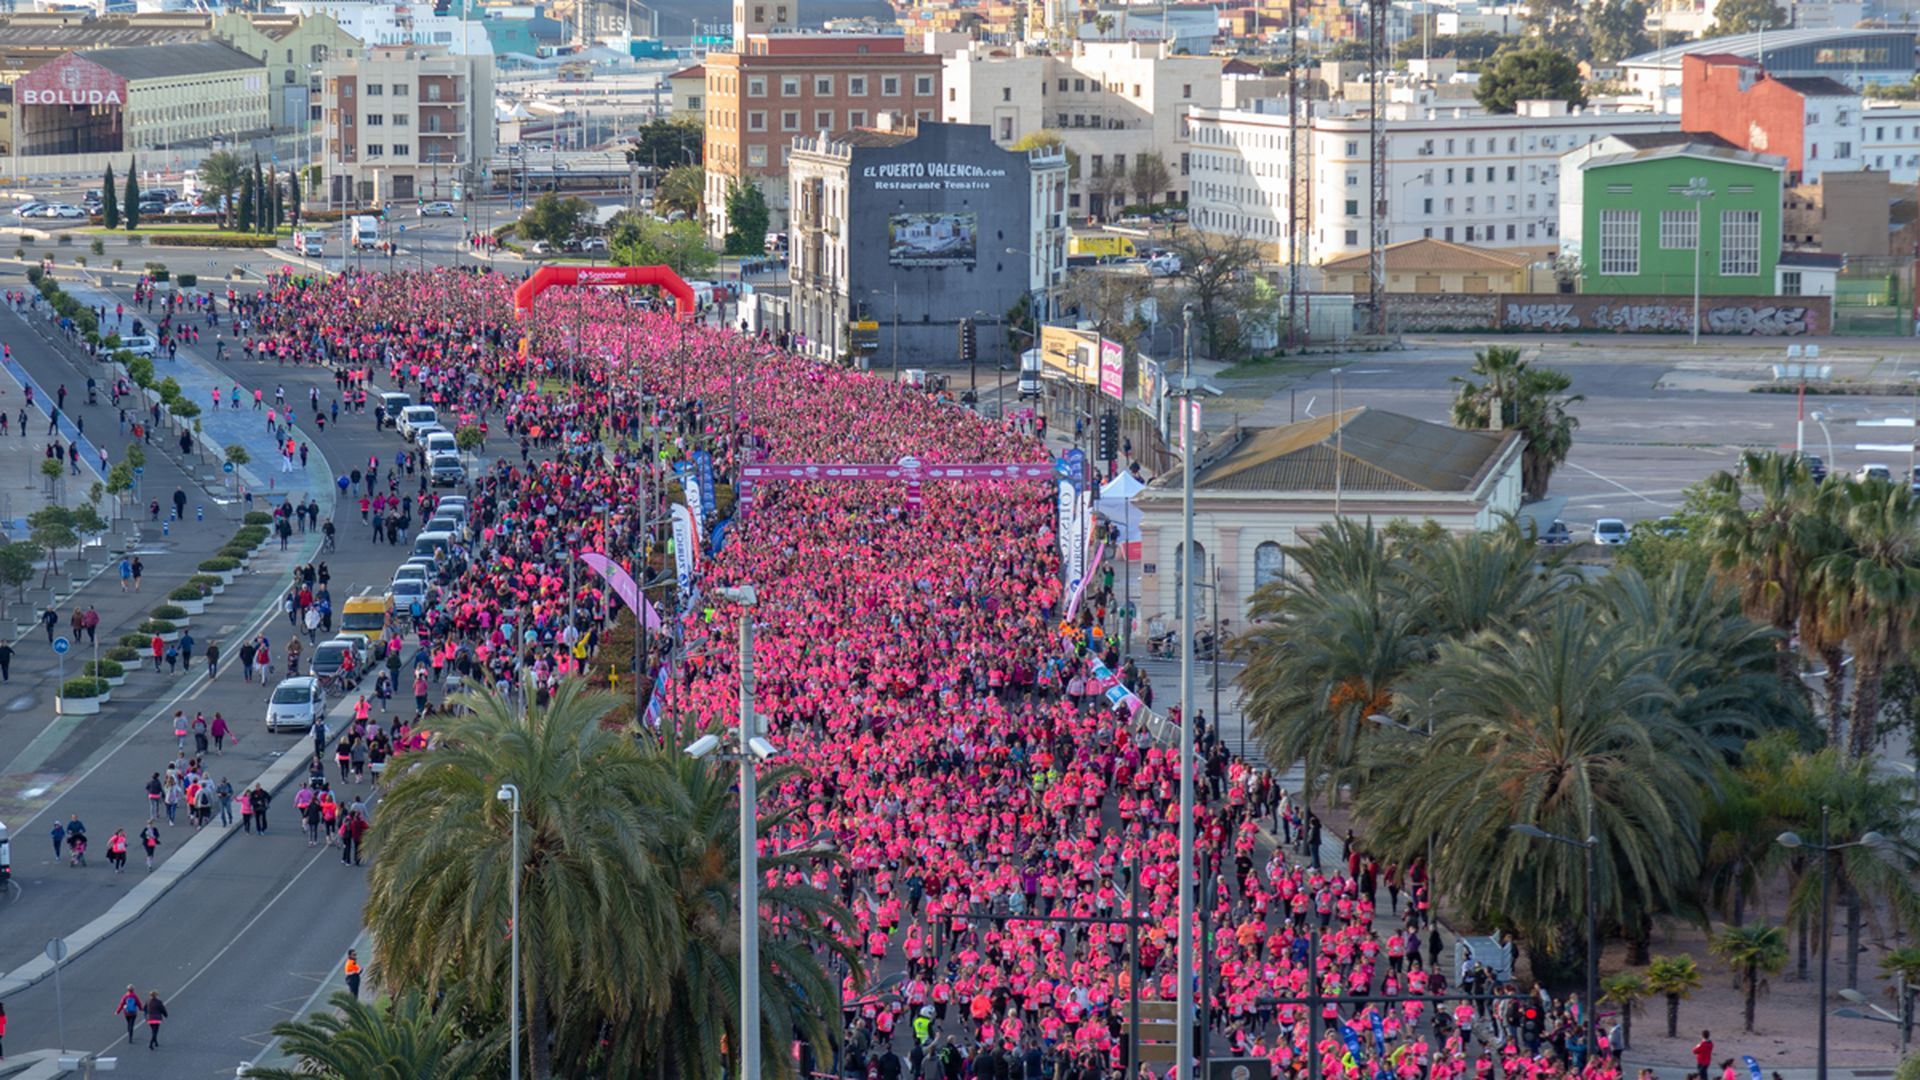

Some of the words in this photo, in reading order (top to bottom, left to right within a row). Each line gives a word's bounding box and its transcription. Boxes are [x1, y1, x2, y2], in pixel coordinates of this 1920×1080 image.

[23, 90, 121, 104] BOLUDA
[863, 166, 877, 177] EL
[879, 163, 924, 177] PUERTO
[875, 181, 941, 190] Restaurante
[588, 271, 626, 280] Santander
[1074, 535, 1082, 575] ZURICH
